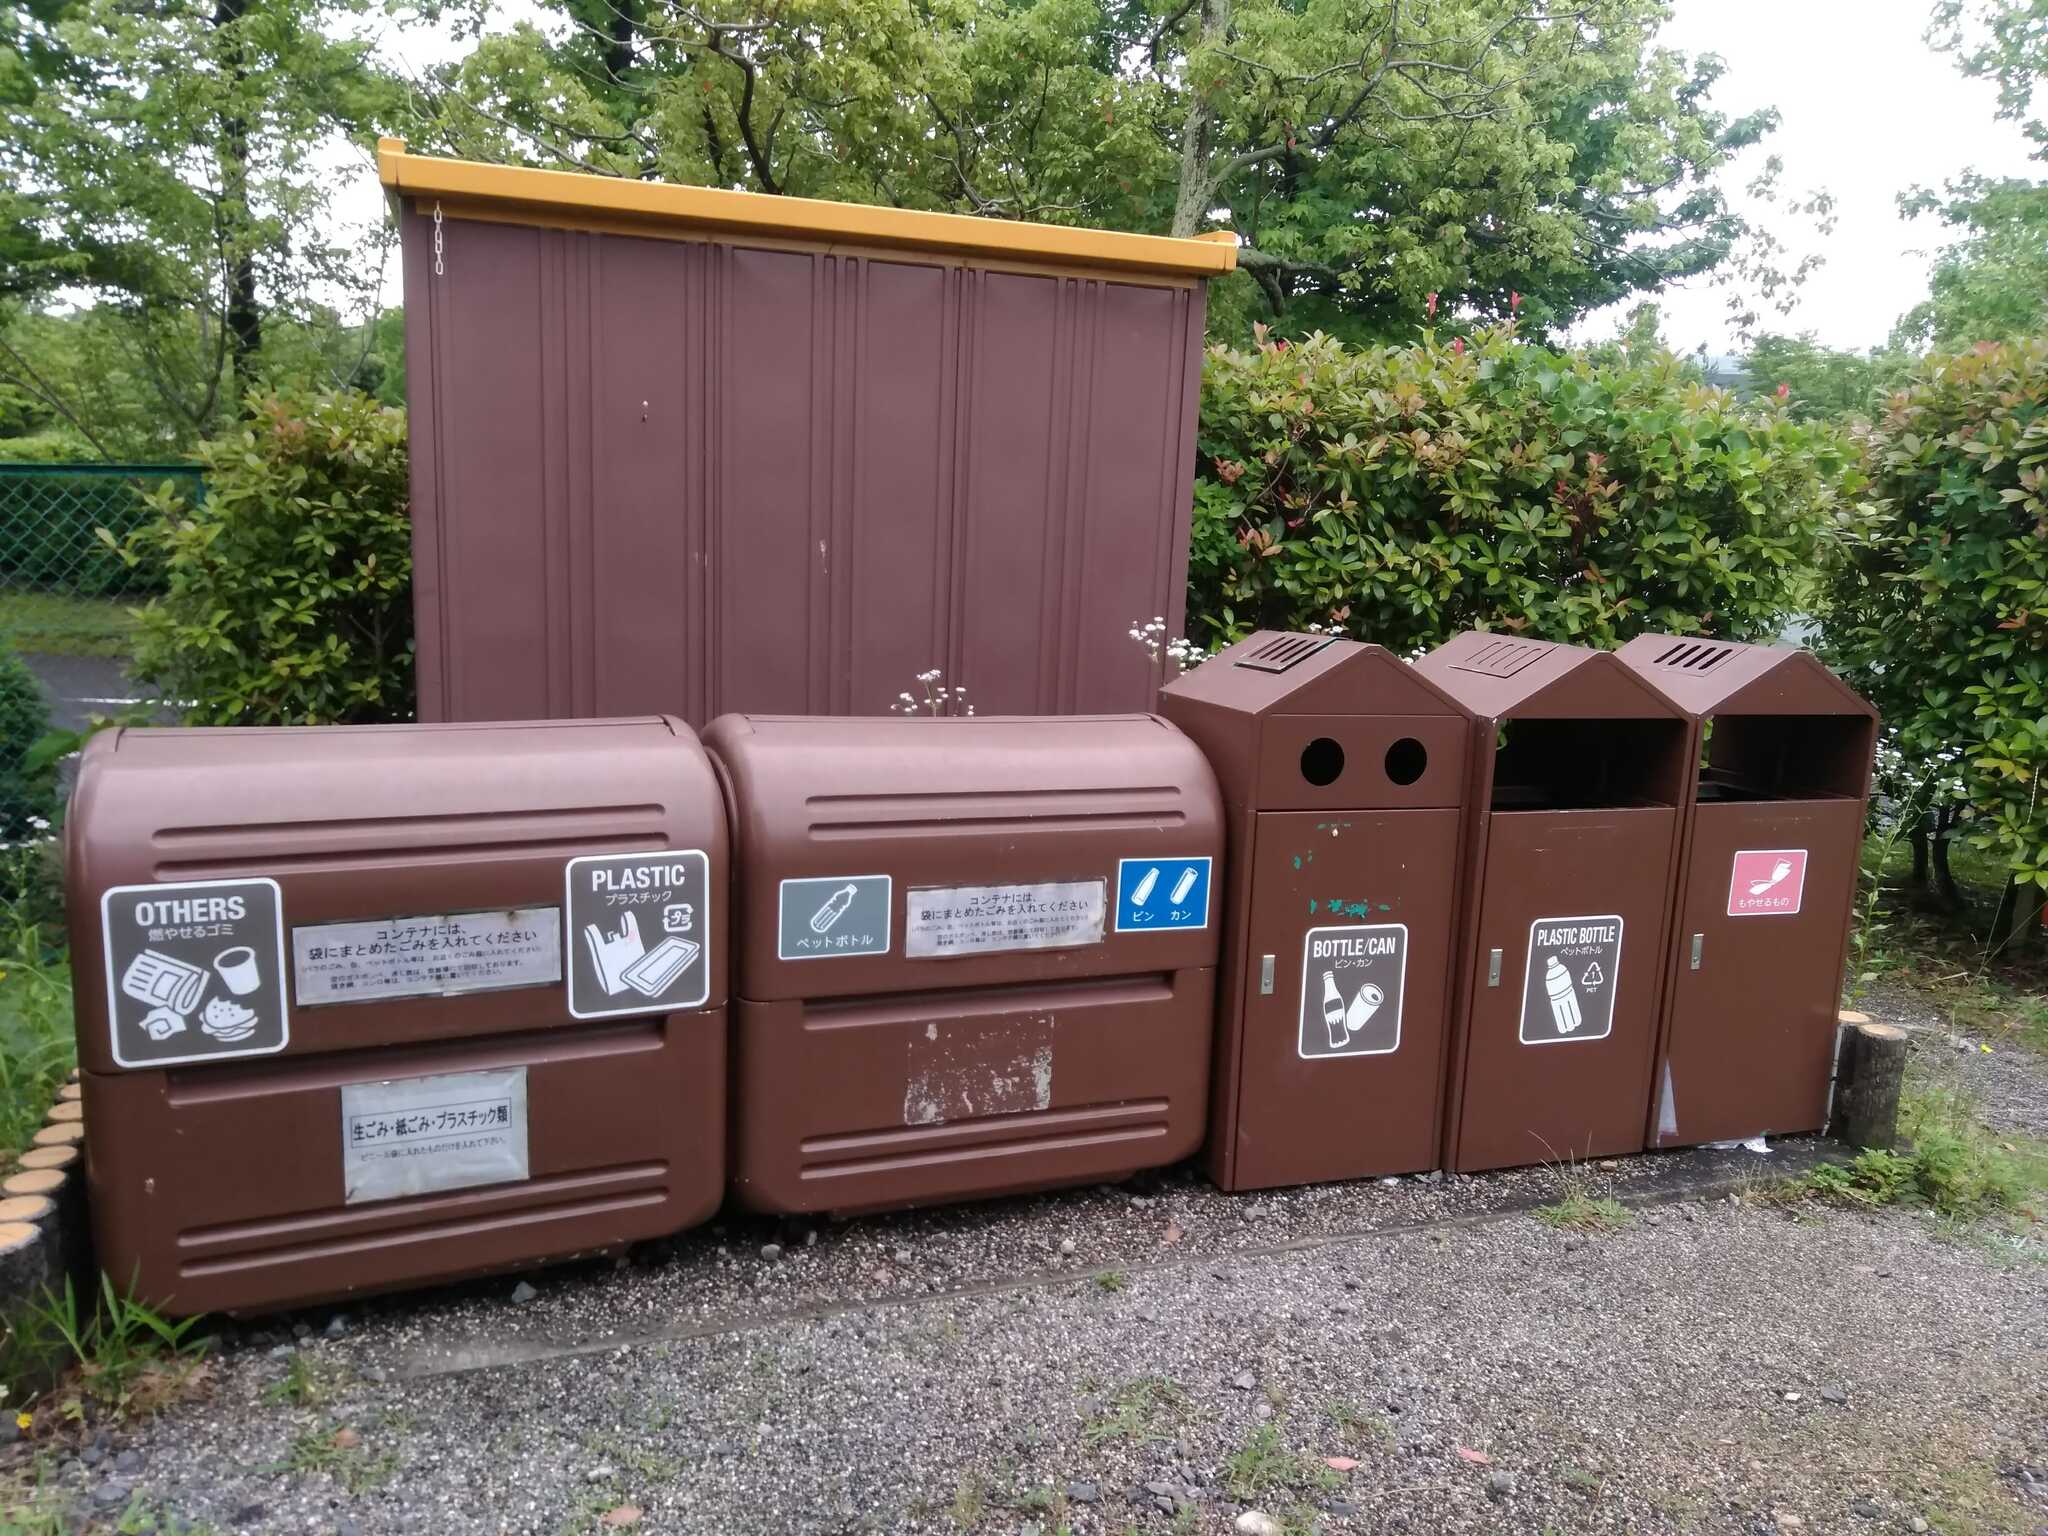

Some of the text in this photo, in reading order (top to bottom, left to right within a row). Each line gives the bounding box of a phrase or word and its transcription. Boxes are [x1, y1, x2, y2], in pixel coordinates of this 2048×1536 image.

[591, 865, 686, 892] PLASTIC
[605, 890, 672, 906] プラスチック
[135, 896, 246, 926] OTHERS
[921, 901, 1088, 920] 袋にまとめたごみを入れてください
[1133, 910, 1191, 921] ビン カン
[148, 923, 234, 942] 燃やせるゴミ
[796, 934, 874, 949] ペットボトル
[1537, 925, 1616, 946] PLASTIC BOTTLE
[308, 930, 537, 961] 袋にまとめたごみを入れてください
[1313, 937, 1396, 958] BOTTLE/CAN
[1560, 945, 1603, 956] ペットボトル
[1335, 958, 1373, 969] ビン・カン
[353, 1105, 509, 1141] 生ごみ・紙ごみ・プラスチック類
